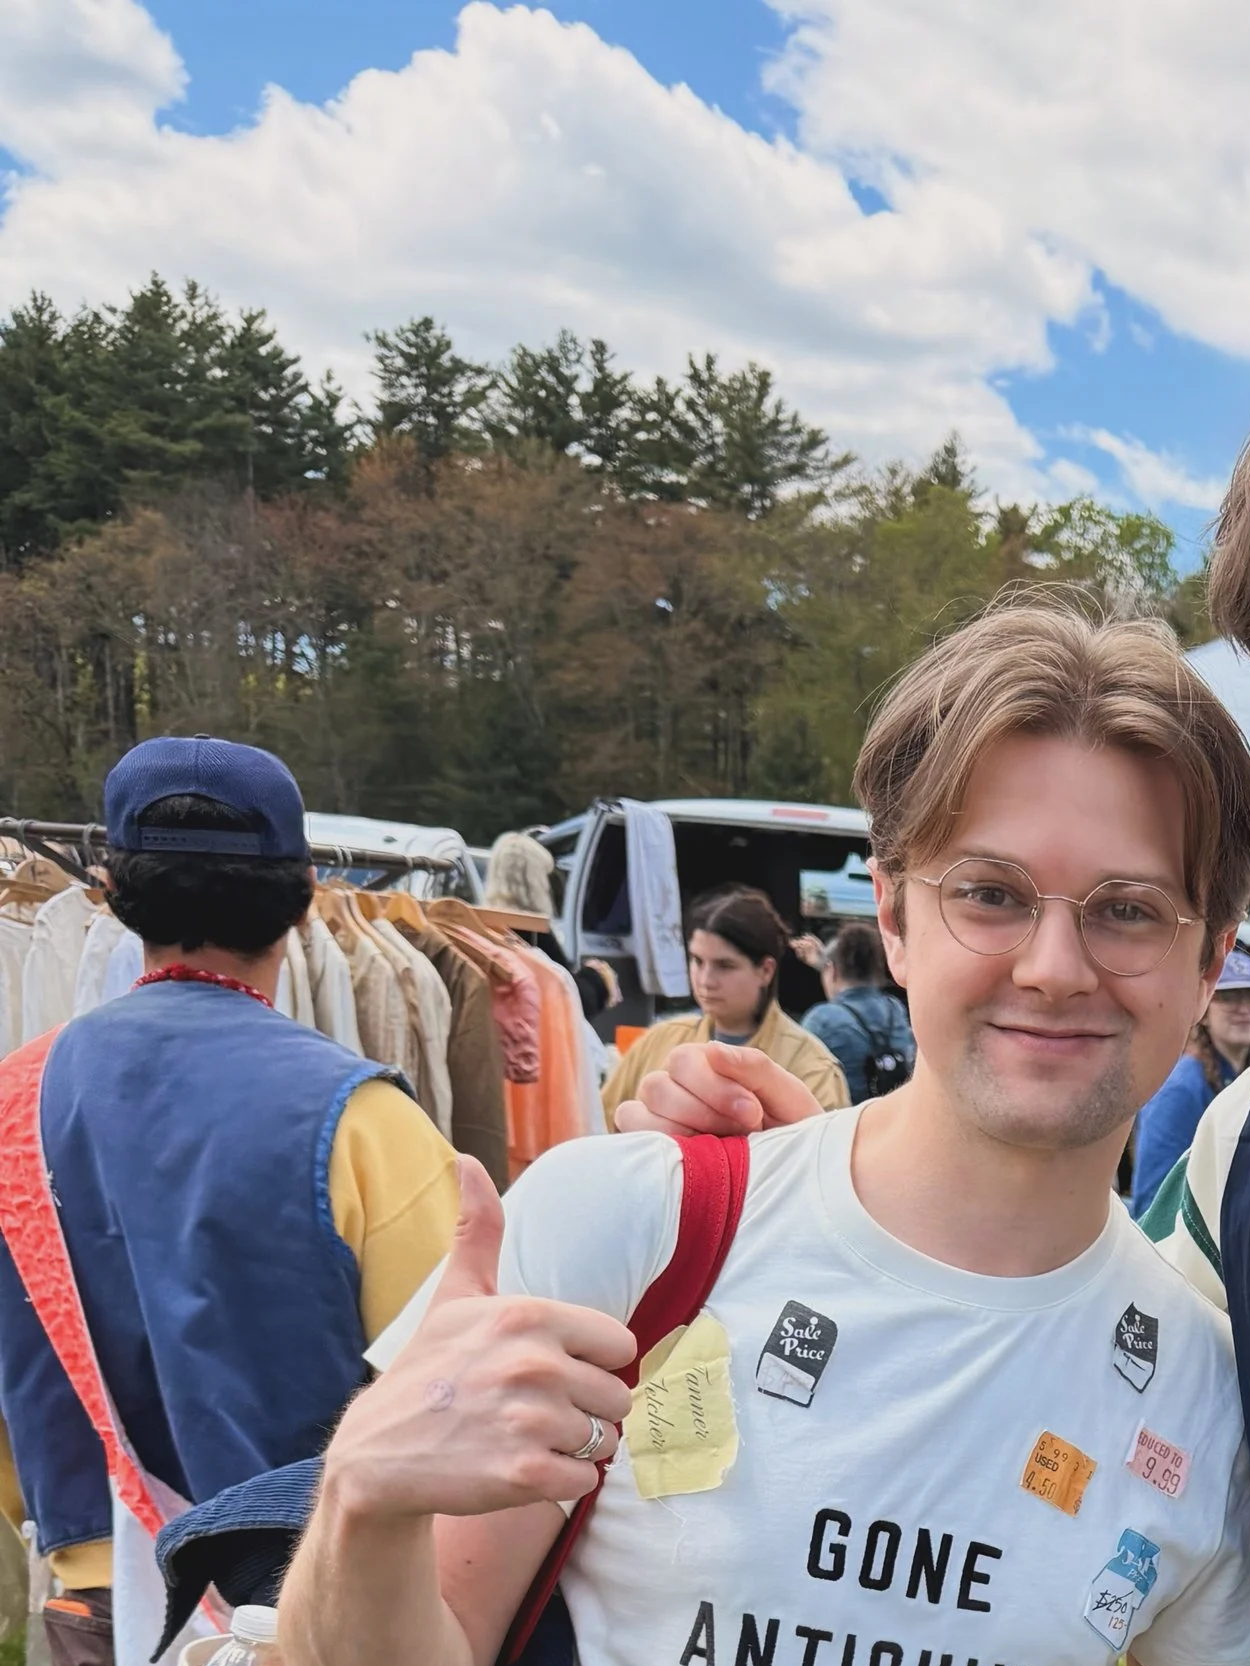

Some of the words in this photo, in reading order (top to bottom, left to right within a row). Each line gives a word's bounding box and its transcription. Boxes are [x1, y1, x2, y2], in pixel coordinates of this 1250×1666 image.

[780, 1316, 821, 1341] Sale
[1120, 1314, 1145, 1334] Sale
[780, 1337, 825, 1361] Price
[1122, 1332, 1153, 1350] Price
[1137, 1430, 1170, 1459] EDUCED
[1034, 1452, 1059, 1472] USED
[1025, 1470, 1057, 1500] 4.50
[1142, 1456, 1181, 1495] 9.99
[807, 1508, 1003, 1612] GONE
